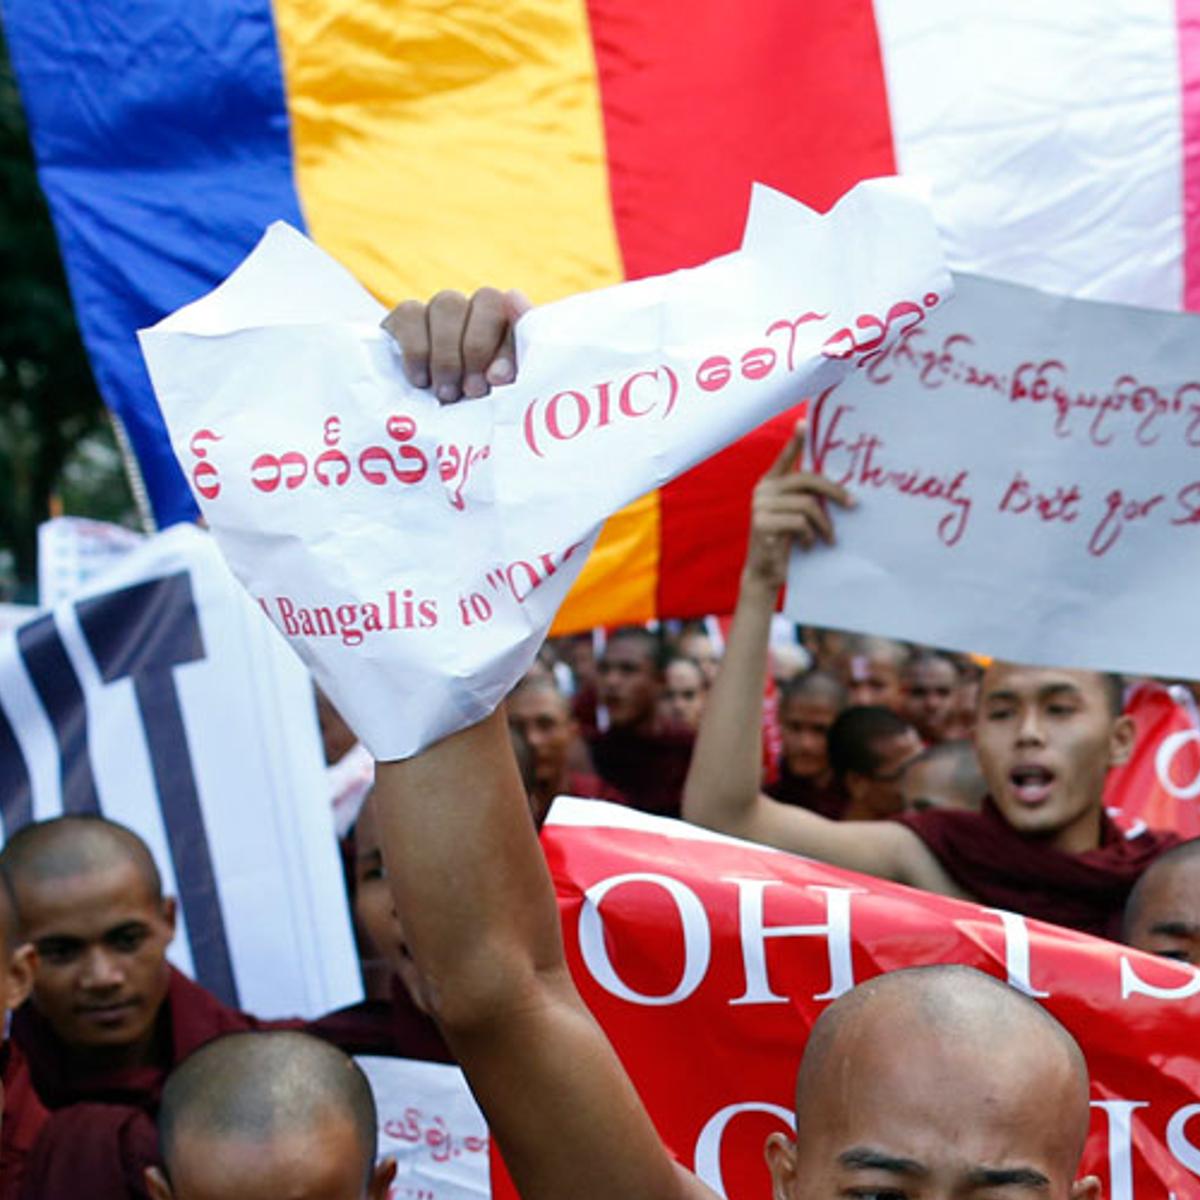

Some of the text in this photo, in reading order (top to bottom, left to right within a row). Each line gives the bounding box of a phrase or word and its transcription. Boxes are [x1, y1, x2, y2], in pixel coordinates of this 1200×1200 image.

[523, 363, 680, 457] (OIC)
[276, 588, 439, 647] Bangalis
[457, 592, 493, 628] to
[577, 872, 868, 1005] OH
